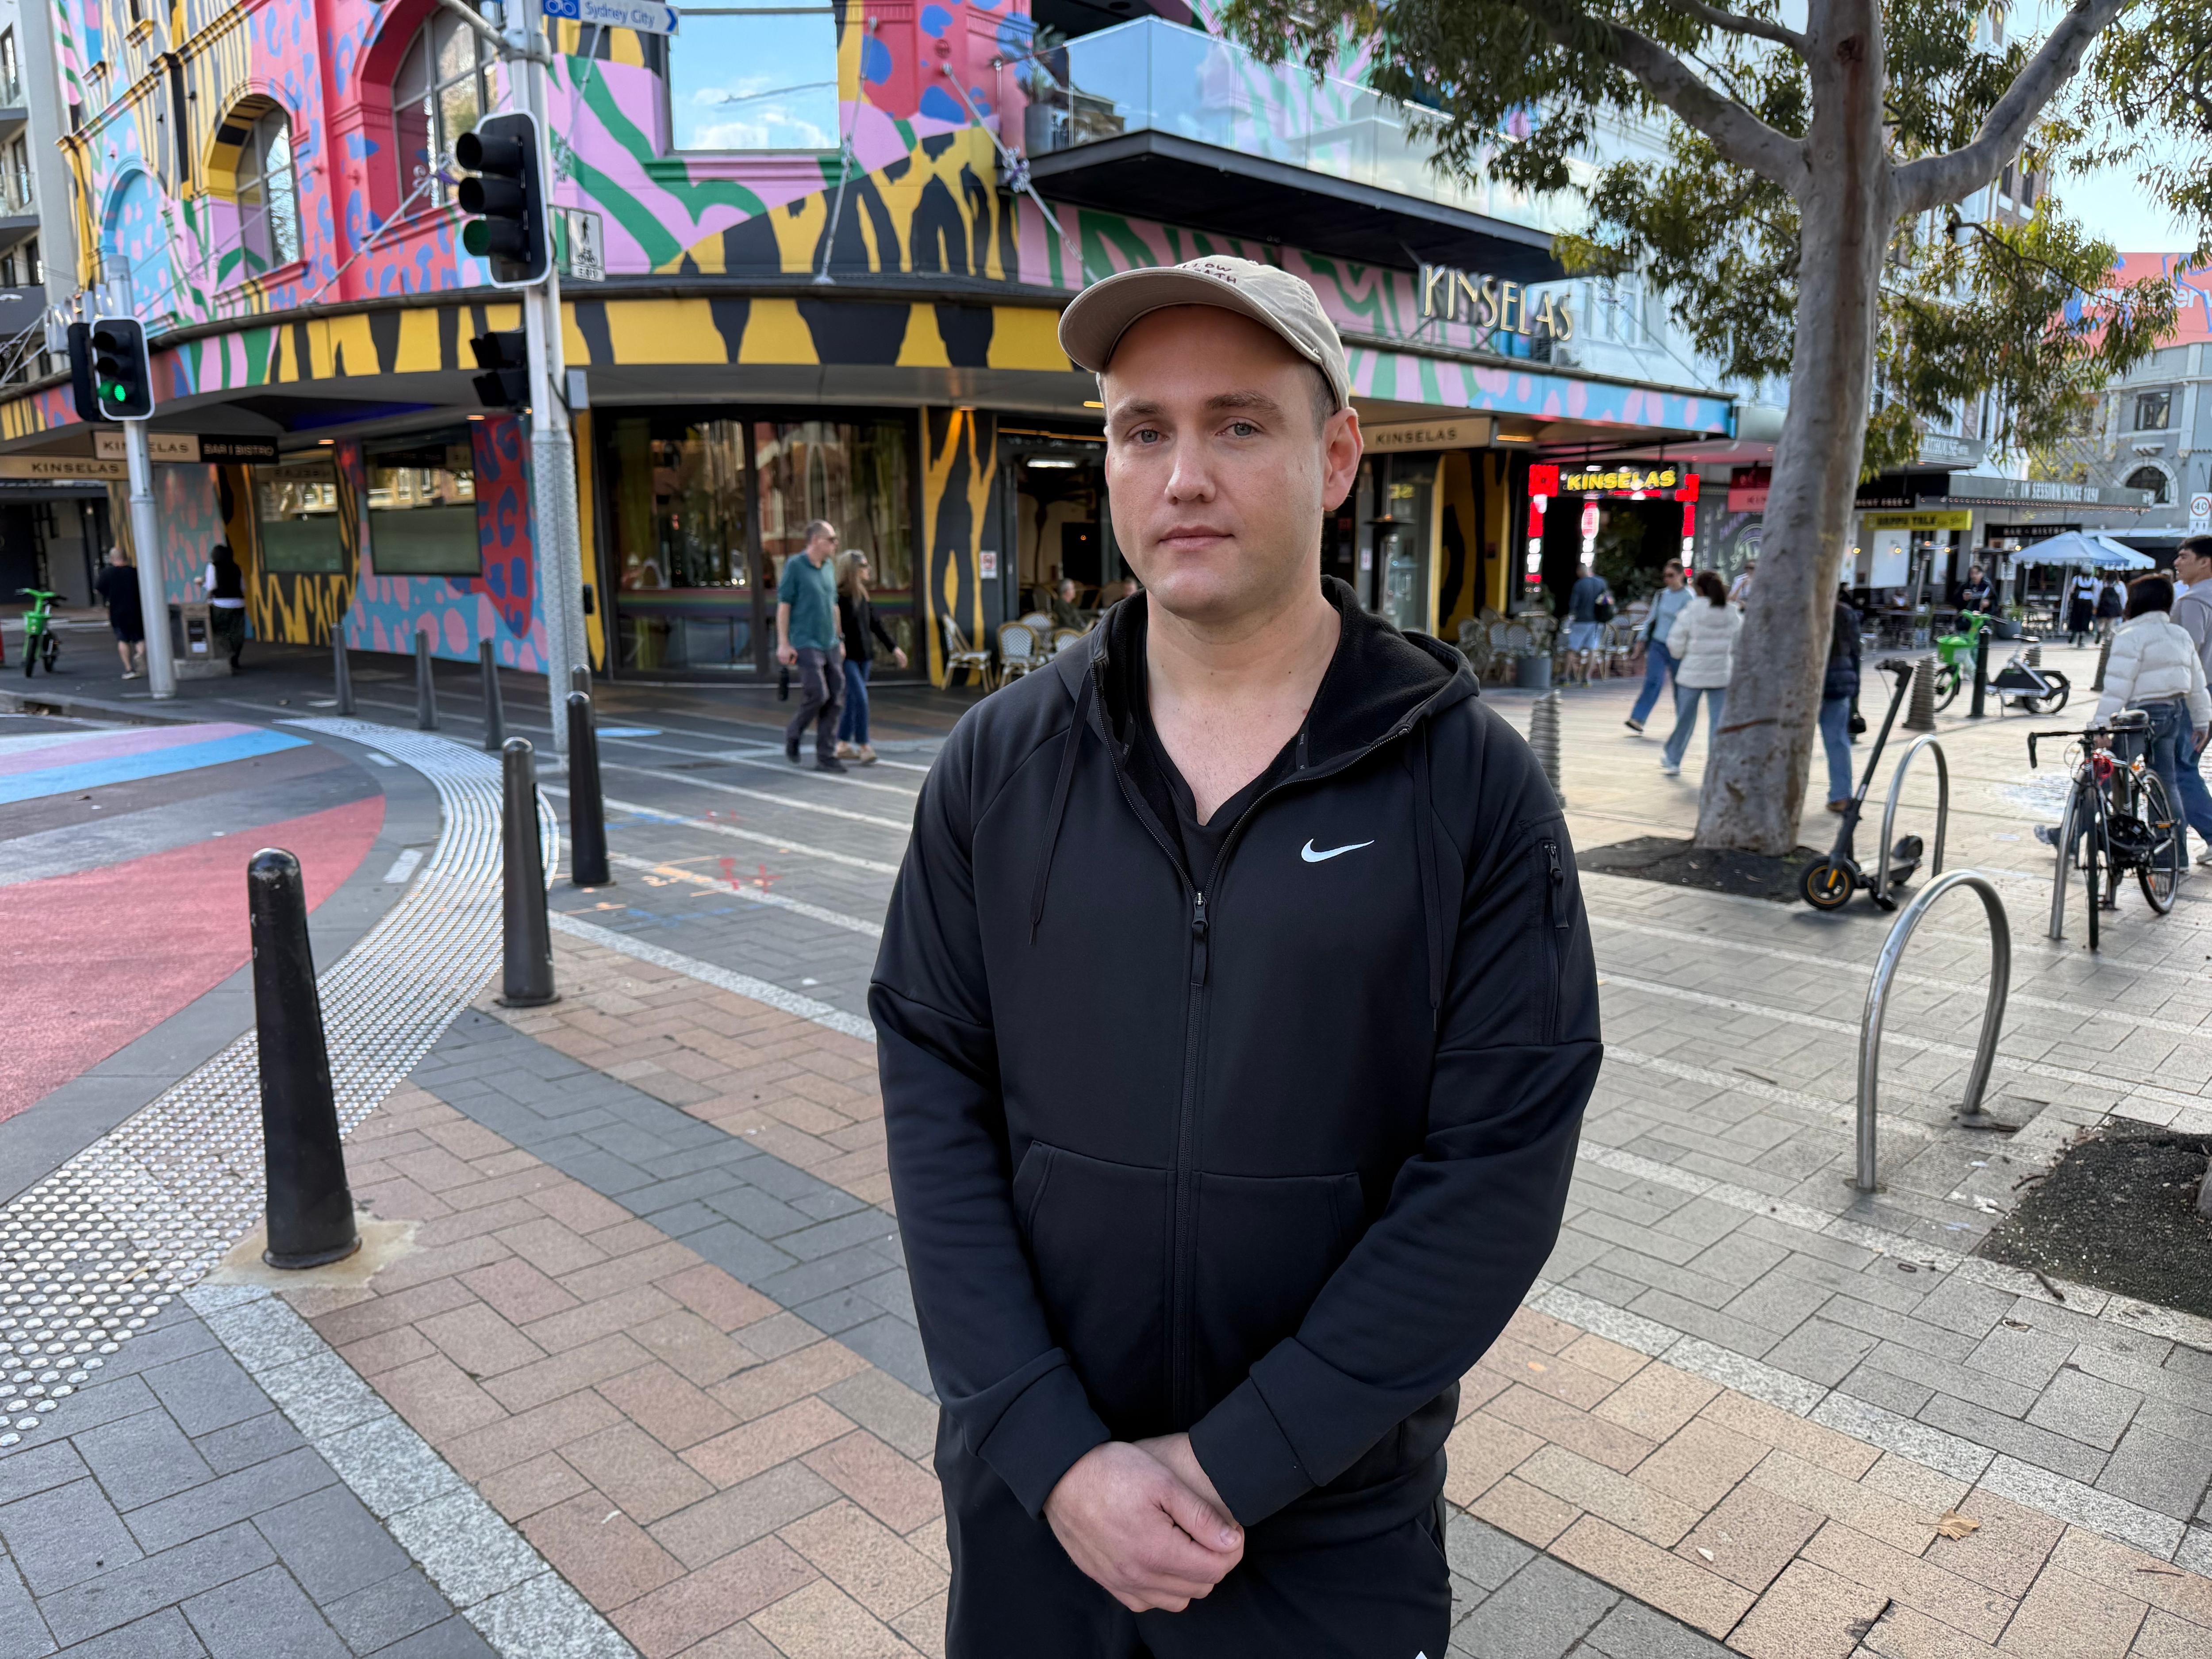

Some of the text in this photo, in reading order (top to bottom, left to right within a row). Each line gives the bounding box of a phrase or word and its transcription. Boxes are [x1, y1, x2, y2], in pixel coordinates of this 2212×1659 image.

[585, 1, 656, 28] Sydney City
[1422, 263, 1573, 341] KINSELAS
[1375, 426, 1458, 445] KINSELAS
[103, 440, 189, 453] KIELAS
[204, 444, 227, 454] BAR
[235, 444, 274, 456] BISTRO
[32, 462, 119, 474] KINSELAS
[1567, 469, 1677, 491] KINSELAS
[2194, 501, 2208, 511] 40
[2003, 527, 2023, 536] BAR
